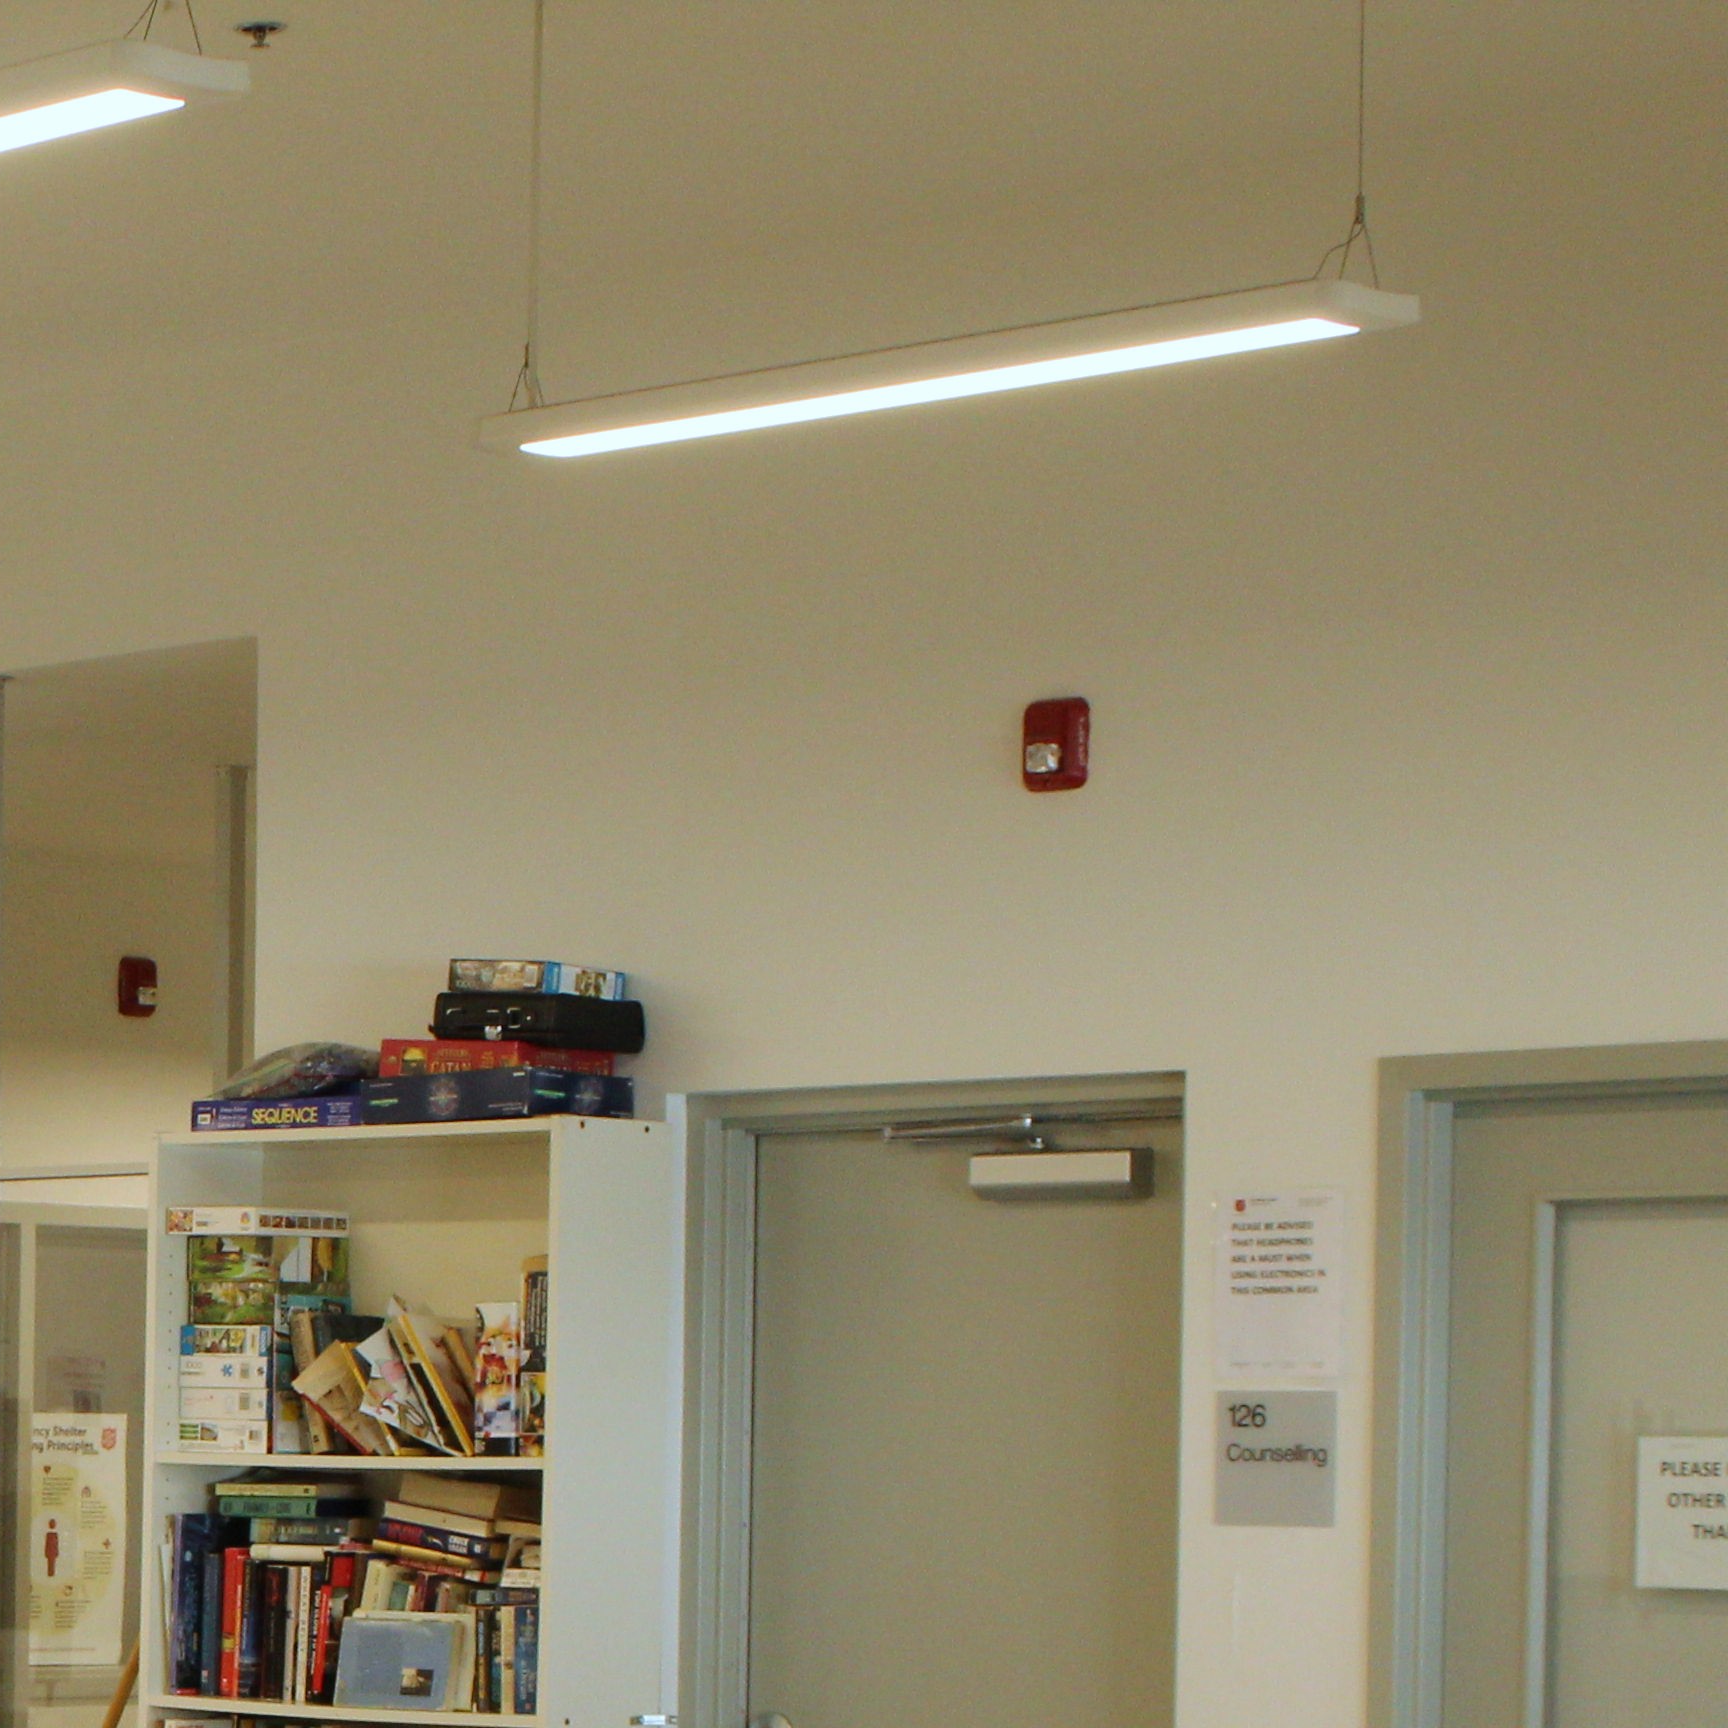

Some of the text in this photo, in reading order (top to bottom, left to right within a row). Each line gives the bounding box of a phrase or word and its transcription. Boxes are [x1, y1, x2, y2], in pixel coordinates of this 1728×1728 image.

[251, 1106, 319, 1125] SEQUENCE
[1232, 1221, 1313, 1231] PLEASE BE ADVISED
[1232, 1237, 1313, 1247] THAT HEADPHONES
[1258, 1254, 1284, 1262] MUST
[1286, 1253, 1312, 1262] WHEN
[1232, 1270, 1257, 1279] USING
[1260, 1269, 1315, 1278] ELECTRONICS
[1232, 1285, 1318, 1295] THIS COMMON AREA
[1228, 1404, 1266, 1428] 126
[53, 1426, 87, 1436] Shelter
[47, 1439, 95, 1452] Principles
[1226, 1443, 1328, 1468] Counselling
[1659, 1461, 1722, 1477] PLEASE
[1666, 1492, 1725, 1508] OTHER
